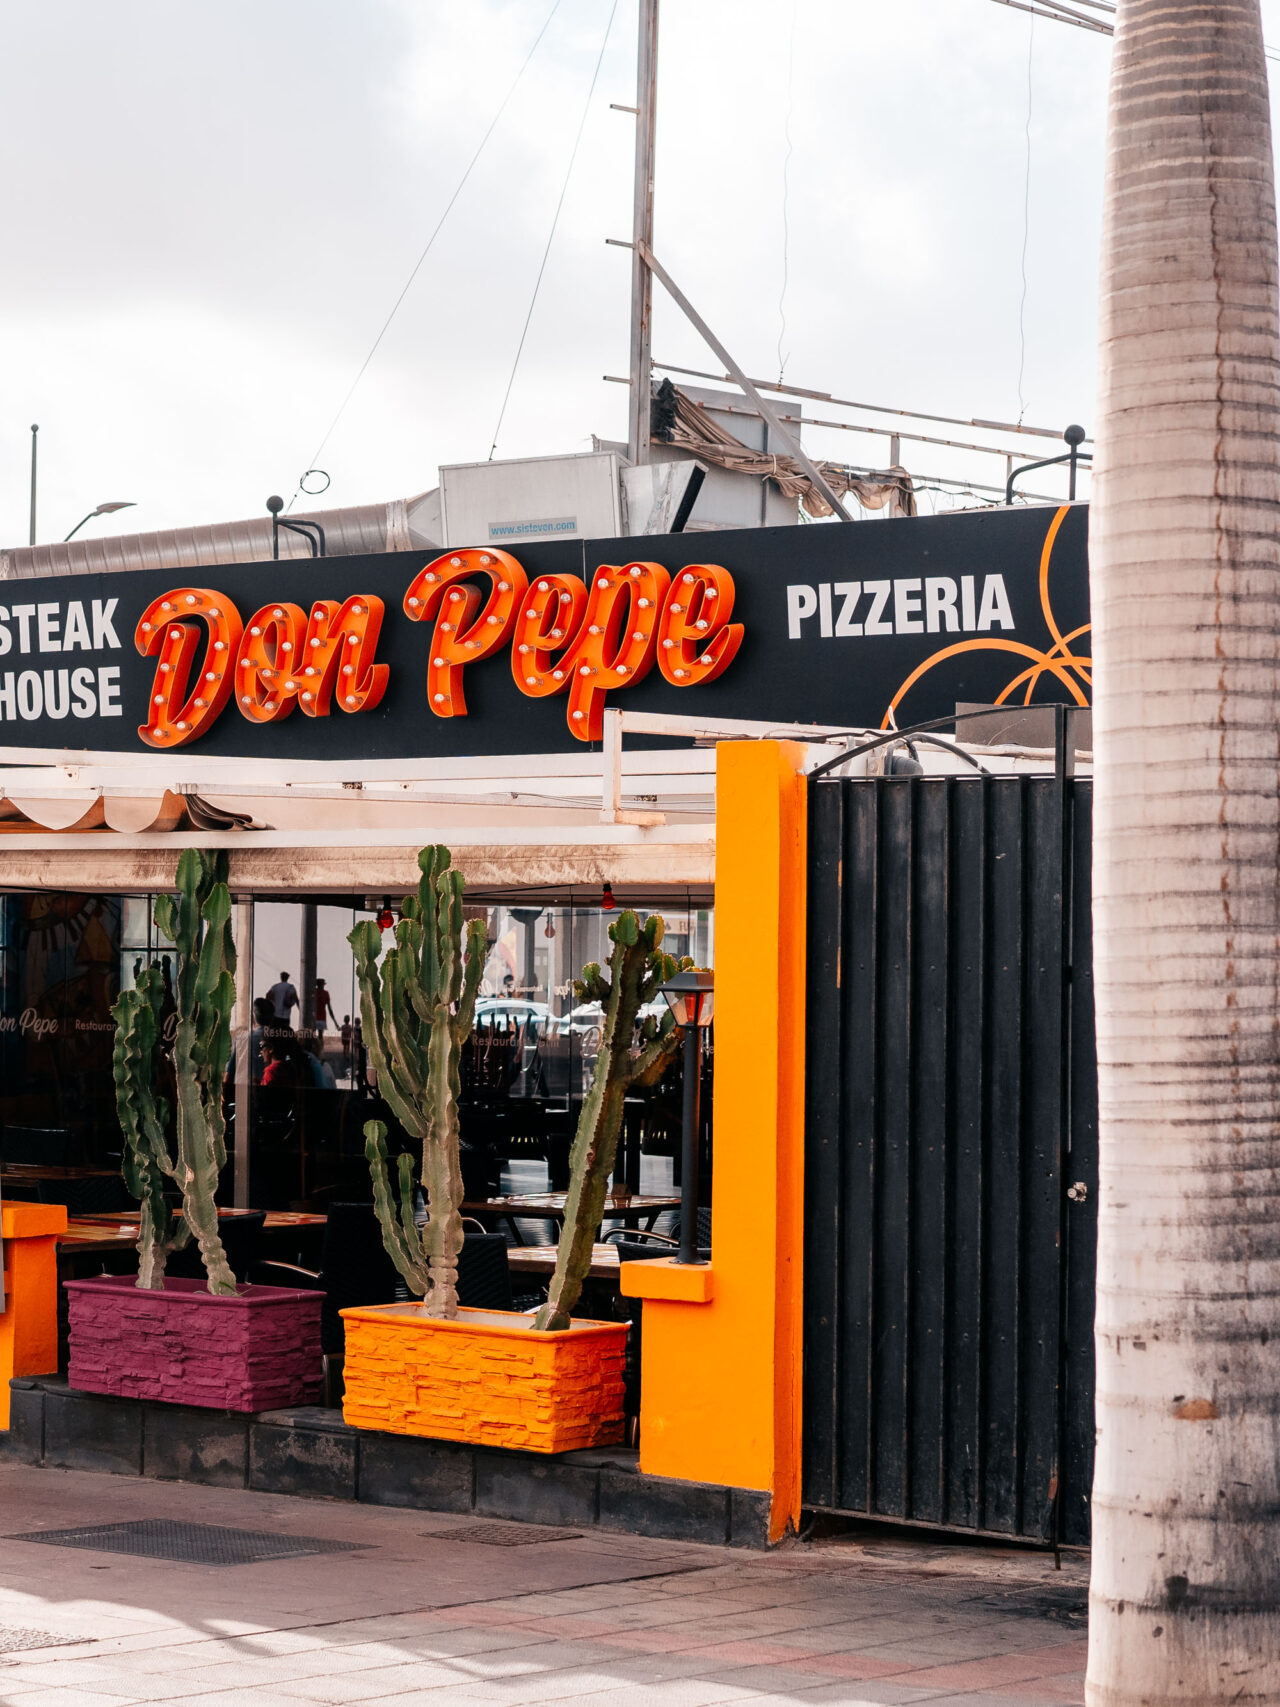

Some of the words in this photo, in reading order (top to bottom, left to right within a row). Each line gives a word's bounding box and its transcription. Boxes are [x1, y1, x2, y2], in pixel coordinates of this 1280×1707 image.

[786, 573, 1016, 640] PIZZERIA
[134, 588, 390, 749] Don
[403, 547, 745, 742] Pepe
[19, 1007, 60, 1041] Pepe
[75, 1019, 119, 1032] Restauran
